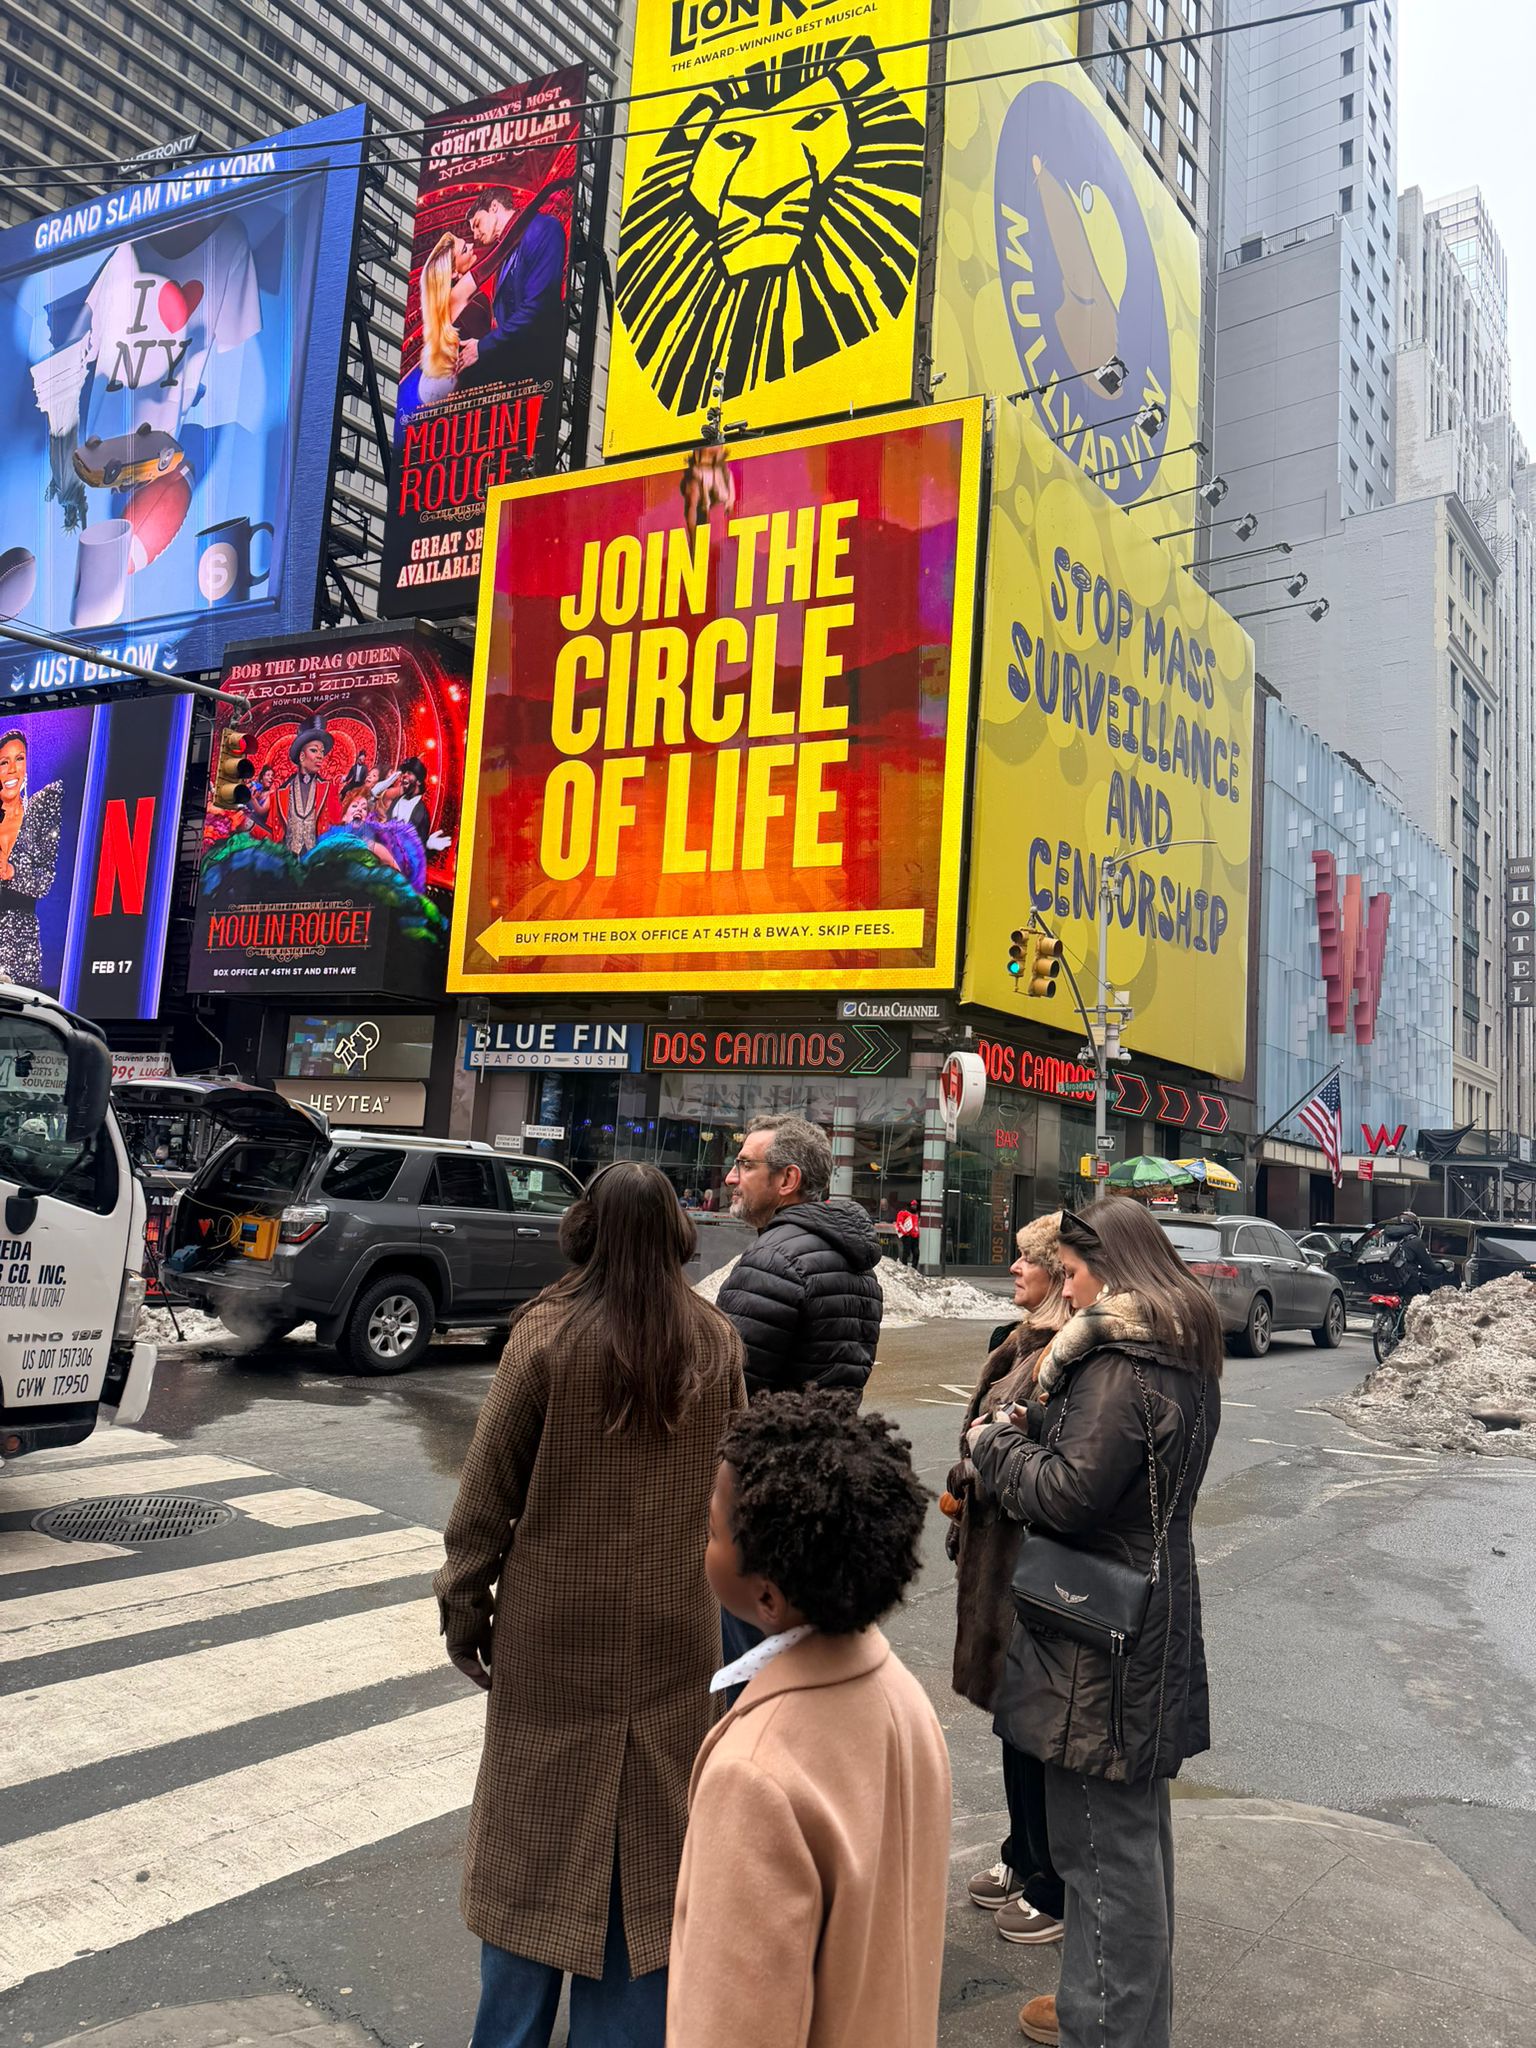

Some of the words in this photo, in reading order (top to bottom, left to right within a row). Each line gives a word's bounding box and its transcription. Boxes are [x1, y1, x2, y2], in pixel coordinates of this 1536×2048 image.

[671, 60, 692, 73] THE
[694, 28, 793, 67] AWARD-WINNING
[796, 20, 822, 35] BEST
[825, 2, 878, 26] MUSICAL
[526, 86, 562, 108] MOST
[428, 98, 572, 170] SPECTACULAR
[438, 150, 509, 181] NIGHT
[35, 206, 101, 250] GRAND
[105, 182, 162, 226] SLAM
[166, 164, 215, 206] NEW
[219, 142, 278, 189] YORK
[126, 279, 156, 335] I
[1001, 203, 1120, 491] MULLVAD
[105, 339, 192, 393] NY
[411, 531, 462, 562] GREAT
[396, 553, 481, 589] AVAILABLE
[559, 523, 712, 632] JOIN
[728, 499, 860, 611] THE
[1051, 546, 1133, 657] STOP
[1143, 608, 1217, 710] MASS
[29, 653, 81, 690] JUST
[231, 663, 261, 680] BOB
[265, 658, 295, 676] THE
[300, 653, 342, 672] DRAG
[346, 646, 401, 669] QUEEN
[551, 602, 855, 756] CIRCLE
[273, 699, 290, 707] NOW
[293, 696, 312, 705] THRU
[313, 693, 340, 703] MARCH
[342, 692, 350, 700] 22
[319, 672, 400, 693] ZIDLER
[1007, 621, 1241, 804] SURVEILLANCE
[539, 756, 646, 882] OF
[661, 739, 850, 875] LIFE
[1106, 770, 1173, 855] AND
[93, 796, 156, 917] N
[1029, 836, 1228, 955] CENSORSHIP
[207, 913, 287, 949] MOULIN
[289, 910, 372, 947] ROUGE!
[515, 932, 540, 944] BUY
[543, 931, 579, 943] FROM
[582, 930, 607, 942] THE
[610, 930, 636, 942] BOX
[641, 928, 688, 941] OFFICE
[692, 928, 711, 940] AT
[714, 927, 749, 939] 45TH
[753, 926, 762, 938] &
[766, 925, 813, 938] BWAY.
[817, 924, 850, 937] SKIP
[854, 923, 895, 936] FEES.
[1511, 886, 1531, 1003] HOTEL
[92, 960, 115, 974] FEB
[117, 960, 133, 974] 17
[213, 968, 228, 977] BOX
[230, 967, 258, 976] OFFICE
[259, 967, 269, 976] AT
[271, 967, 291, 976] 45TH
[292, 967, 302, 976] ST
[304, 966, 321, 975] AND
[323, 966, 338, 975] 8TH
[340, 966, 357, 975] AVE
[474, 1024, 557, 1050] BLUE
[572, 1024, 628, 1051] FIN
[653, 1031, 706, 1065] DOS
[714, 1032, 845, 1067] CAMINOS
[473, 1053, 552, 1065] SEAFOOD
[573, 1055, 627, 1066] SUSHI
[978, 1040, 1015, 1084] DOS
[309, 1093, 384, 1113] HEYTEA
[994, 1129, 1019, 1149] BAR
[1360, 1123, 1407, 1155] W
[0, 1240, 32, 1262] EDA
[8, 1263, 31, 1285] CO.
[38, 1264, 67, 1286] INC.
[29, 1287, 42, 1308] NJ
[42, 1288, 65, 1308] 07047
[7, 1332, 64, 1344] HINO
[71, 1329, 103, 1341] 195
[22, 1349, 36, 1370] US
[38, 1348, 57, 1370] DOT
[58, 1347, 94, 1369] 1517306
[17, 1376, 46, 1399] GVW
